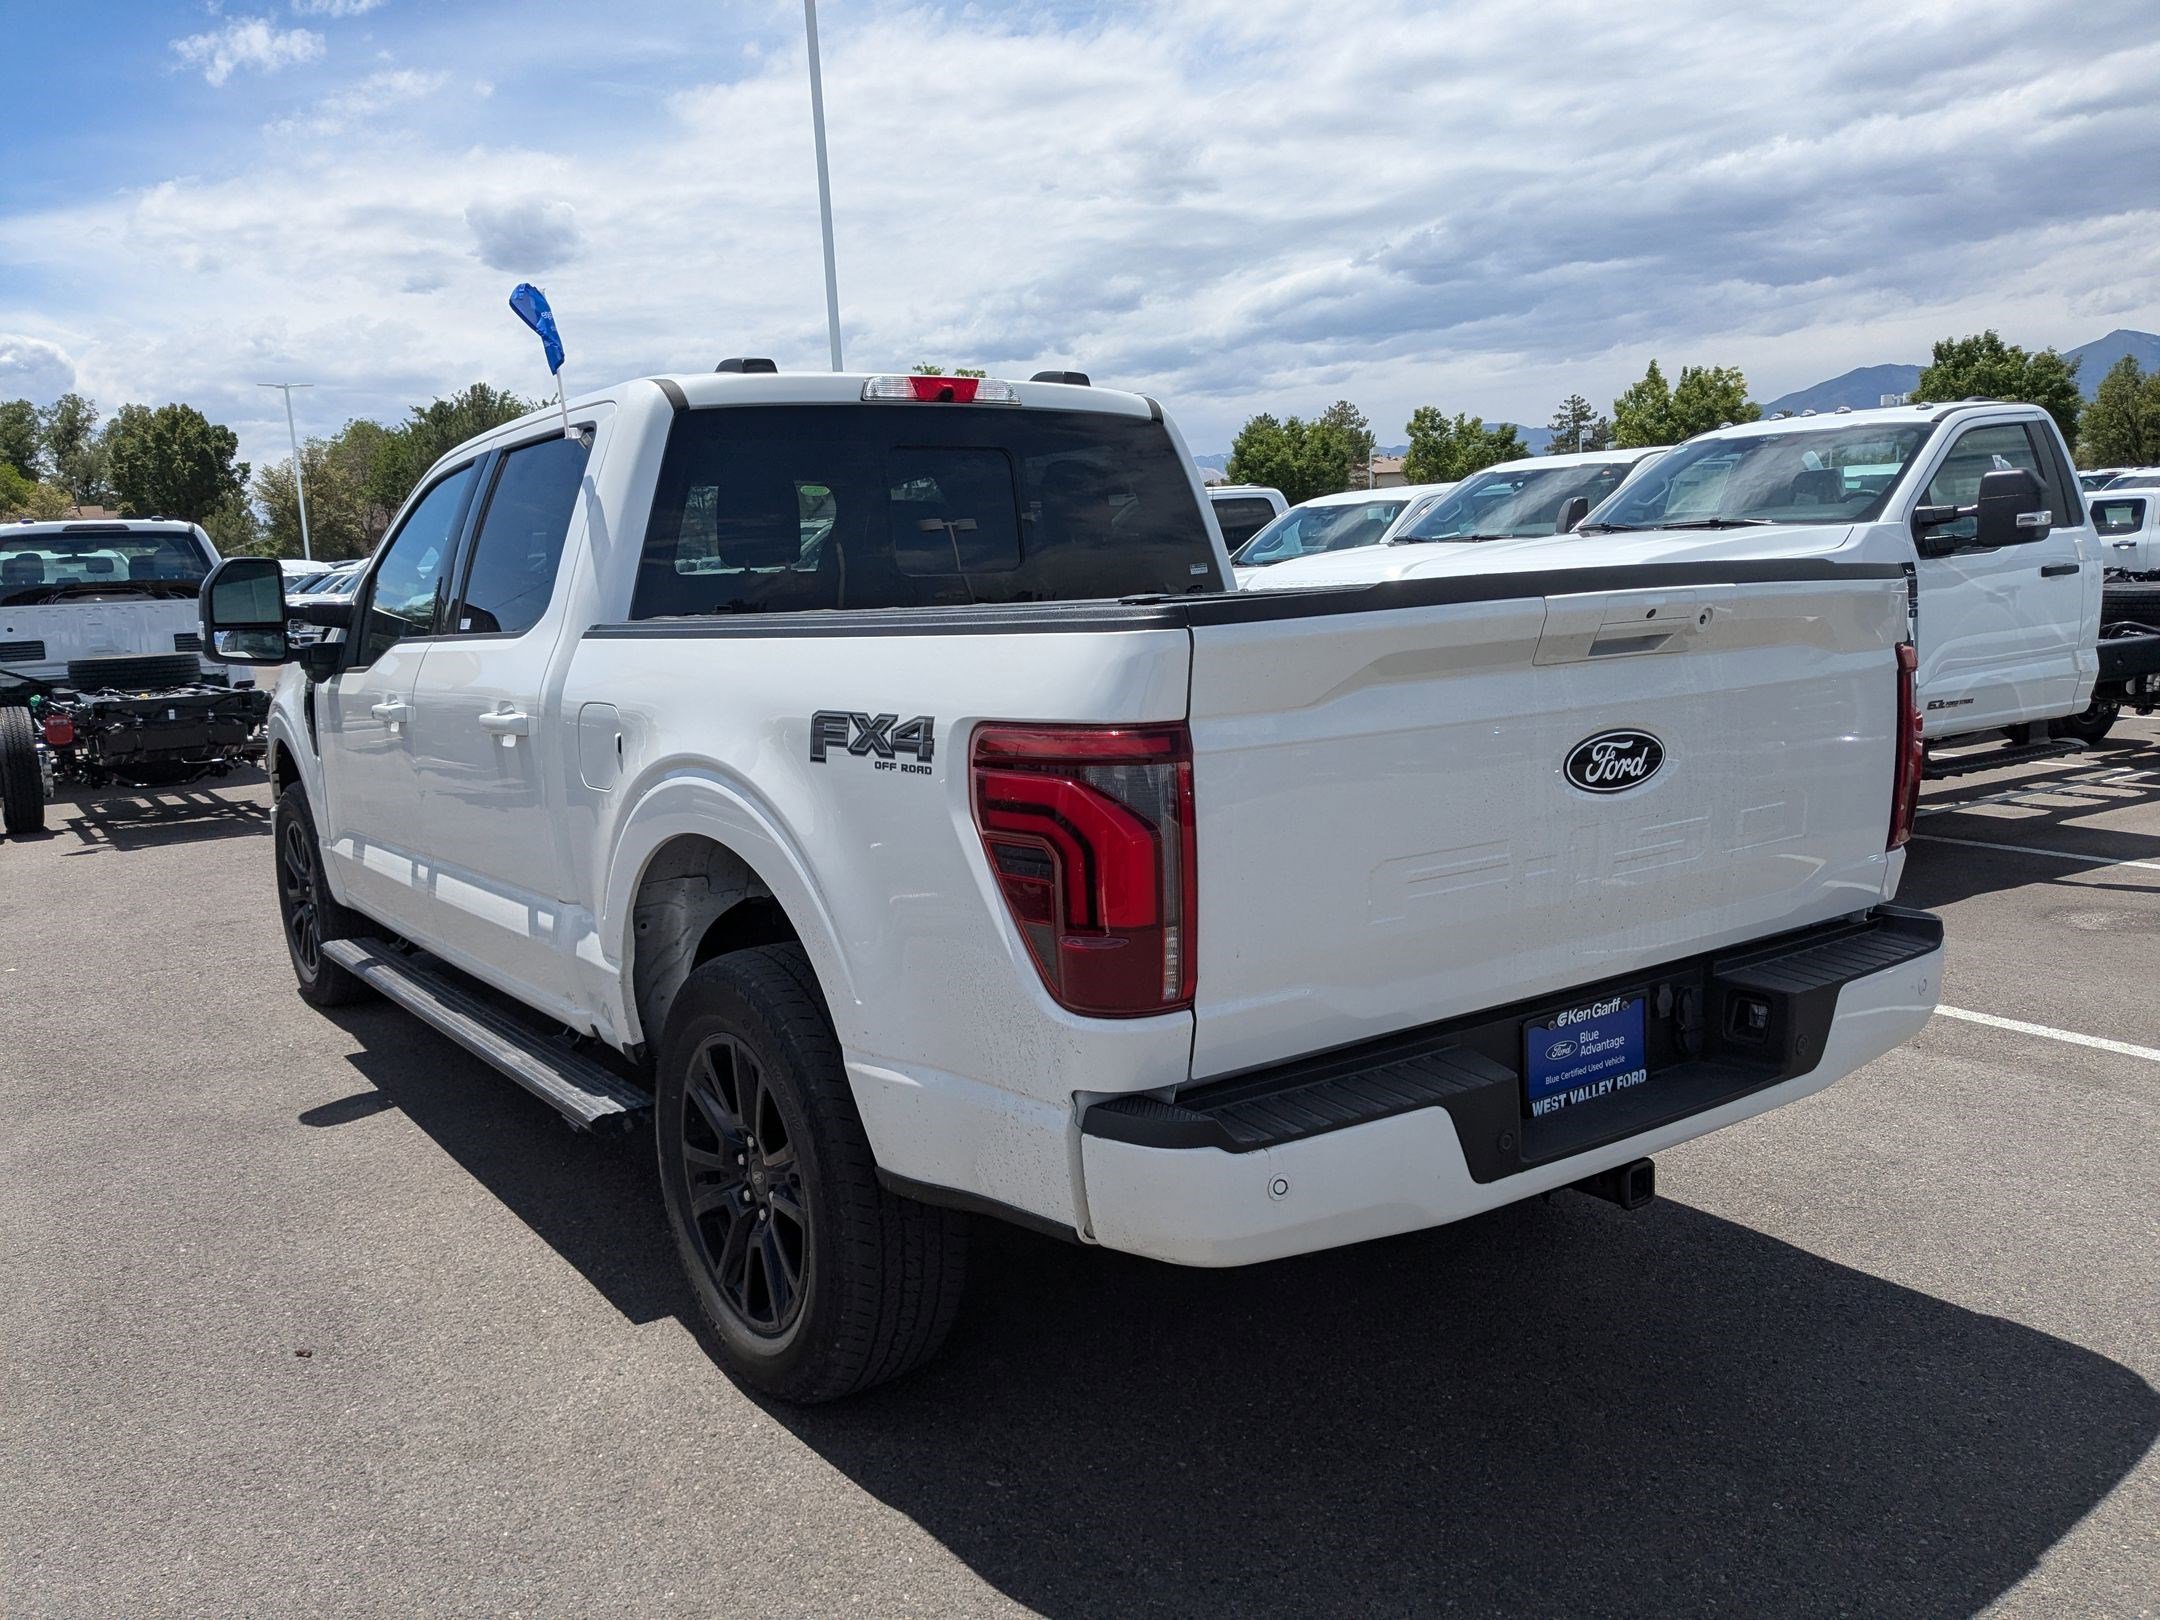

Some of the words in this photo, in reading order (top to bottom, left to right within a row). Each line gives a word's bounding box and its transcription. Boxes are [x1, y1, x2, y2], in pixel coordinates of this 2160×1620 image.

[810, 710, 935, 763] FX4
[874, 761, 897, 772] OFF
[900, 763, 933, 775] ROAD
[1585, 740, 1649, 783] Ford
[1567, 1008, 1591, 1025] Ken
[1592, 998, 1621, 1018] Garff
[1551, 1042, 1572, 1058] Ford
[1580, 1030, 1599, 1044] Blue
[1580, 1036, 1625, 1057] Advantage
[1545, 1074, 1560, 1085] Blue
[1561, 1065, 1587, 1081] Certified
[1588, 1060, 1604, 1073] Used
[1604, 1055, 1626, 1068] Vehicle
[1532, 1093, 1567, 1118] WEST
[1569, 1078, 1614, 1105] VALLEY
[1617, 1068, 1647, 1091] FORD
